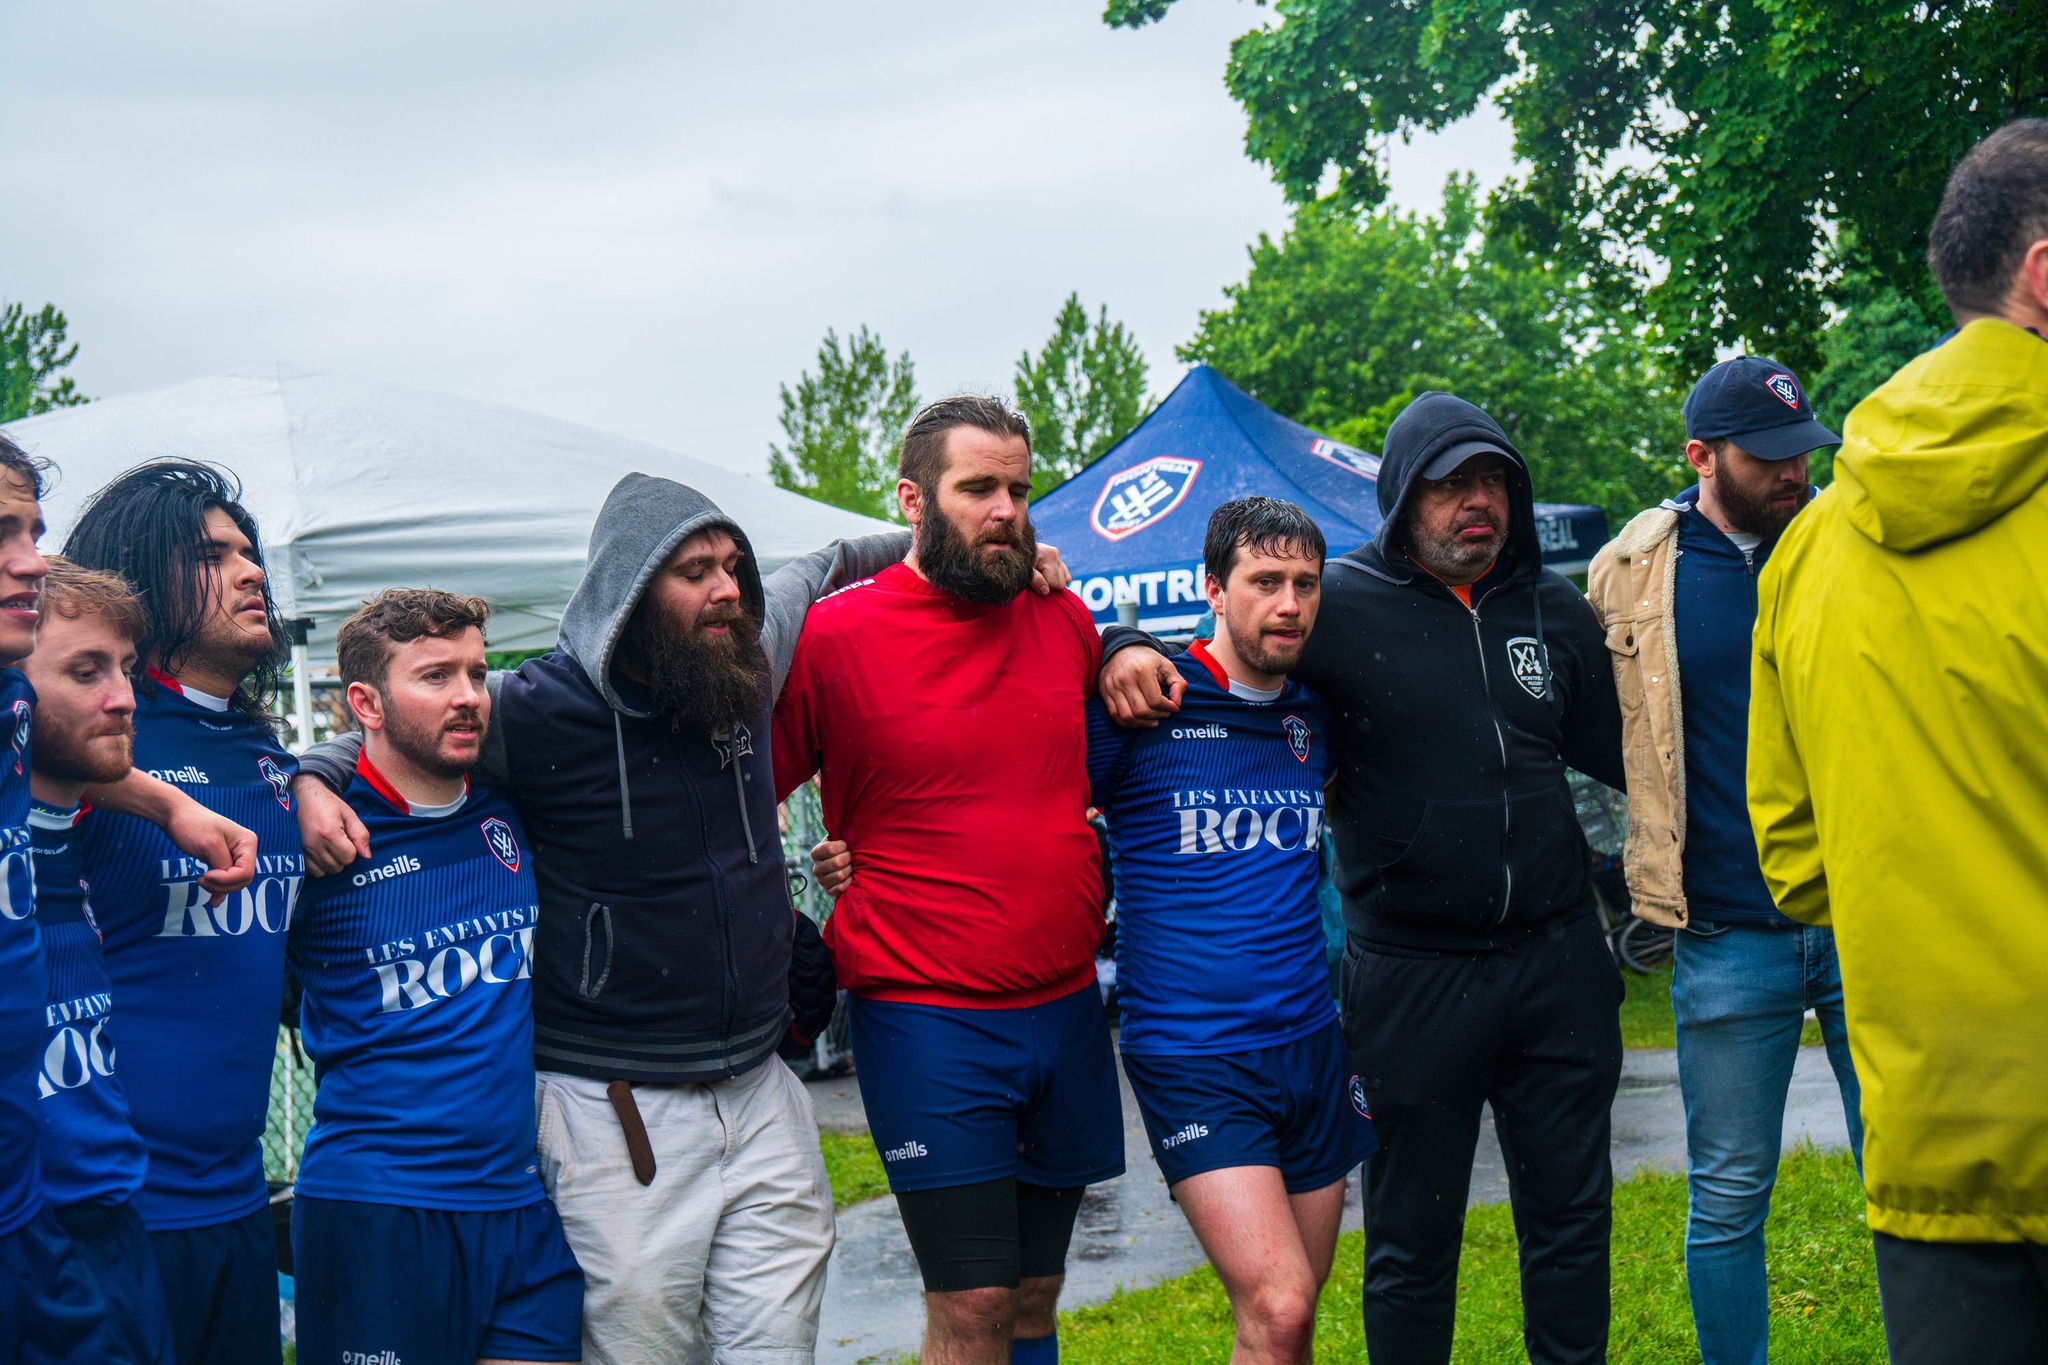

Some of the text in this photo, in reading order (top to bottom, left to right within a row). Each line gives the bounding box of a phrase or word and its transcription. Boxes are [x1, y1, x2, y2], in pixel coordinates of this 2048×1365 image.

[1173, 789, 1216, 808] LES
[1223, 789, 1311, 805] ENFANTS
[161, 857, 209, 879] LES
[366, 937, 416, 965] LES
[424, 907, 524, 949] ENFANTS
